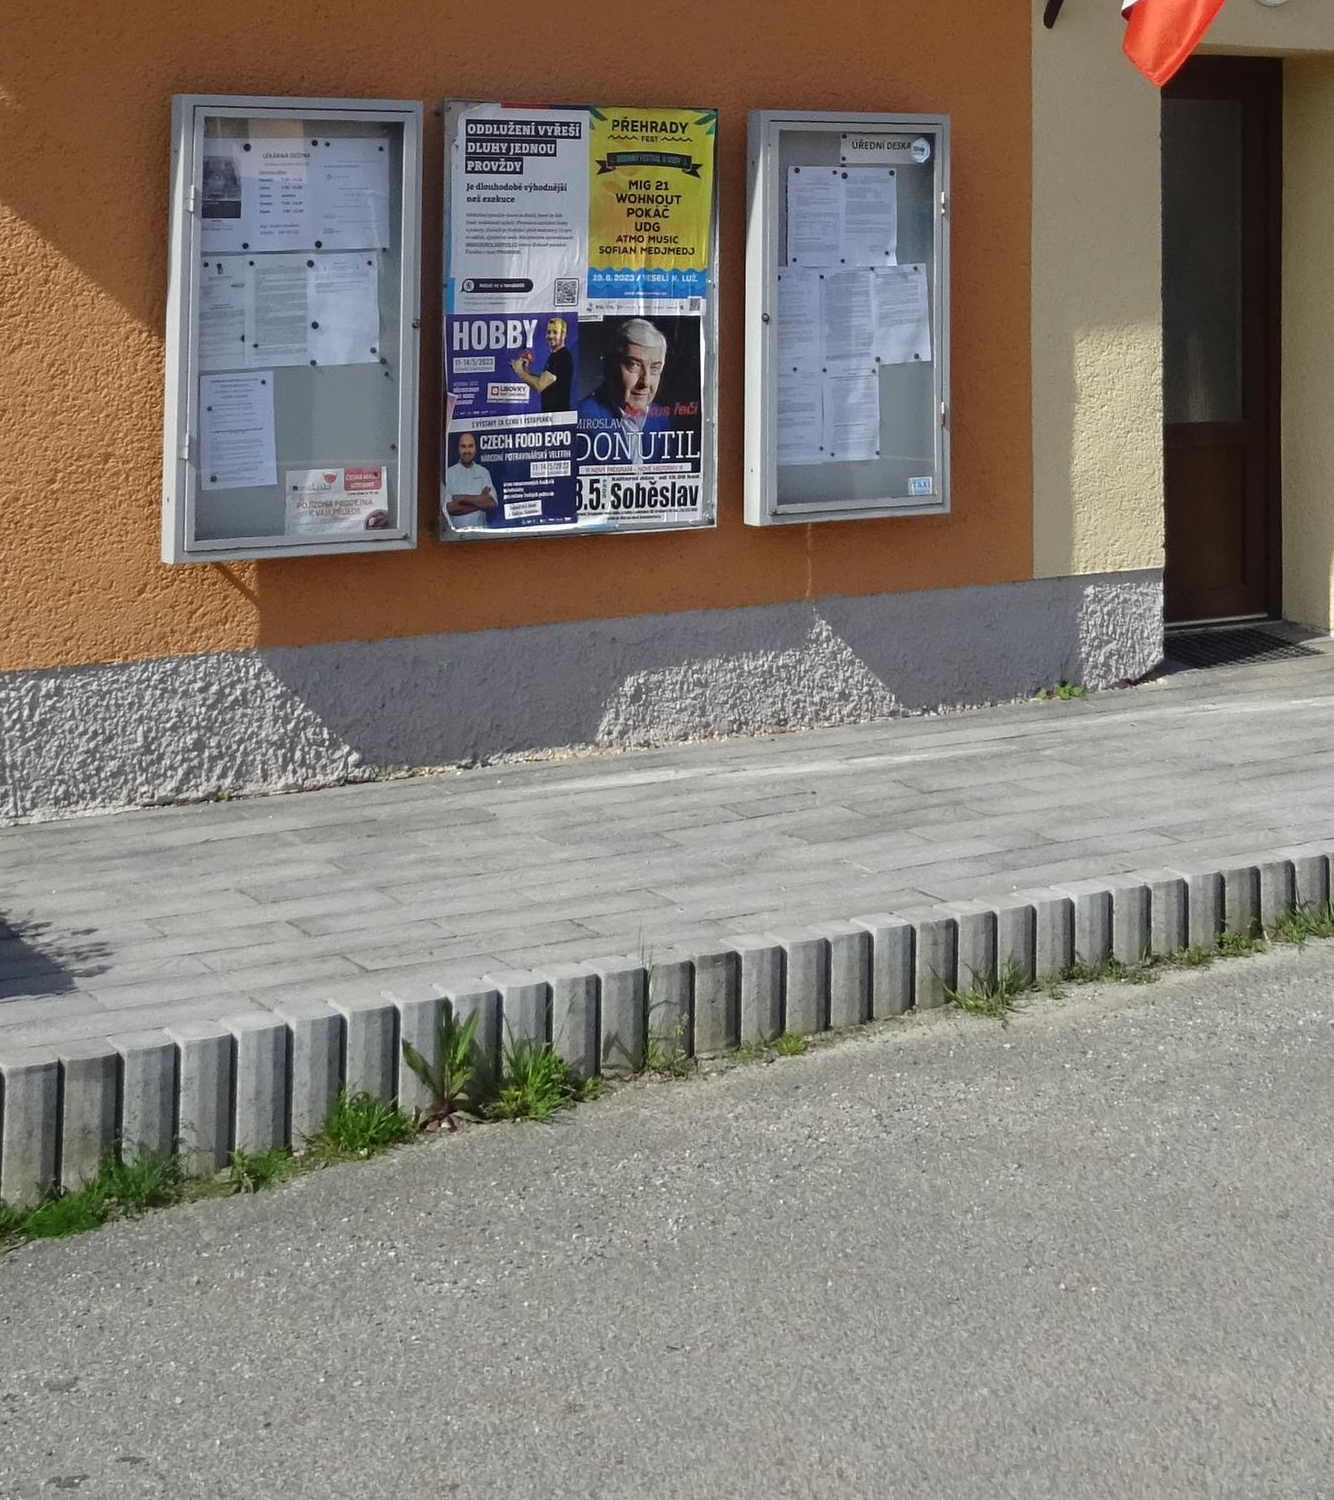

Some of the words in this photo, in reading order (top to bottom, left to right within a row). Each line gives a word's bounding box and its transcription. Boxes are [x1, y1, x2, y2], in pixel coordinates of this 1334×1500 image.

[467, 121, 535, 136] ODDLUŽENÍ
[537, 122, 580, 137] VYŘEŠÍ
[611, 116, 689, 134] PŘEHRADY
[641, 135, 658, 143] FEST
[851, 139, 885, 150] ÚŘEDNÍ
[886, 141, 912, 150] DESKA
[467, 142, 508, 153] DLUHY
[509, 143, 555, 155] JEDNOU
[466, 158, 522, 172] PROVŽDY
[466, 183, 475, 192] Je
[475, 183, 523, 192] dlouhodobě
[523, 183, 568, 193] výhodnější
[628, 180, 651, 191] MIG
[655, 180, 669, 191] 21
[466, 195, 481, 203] než
[482, 195, 515, 203] exekuce
[615, 193, 682, 205] WOHNOUT
[626, 205, 670, 219] POKÁČ
[634, 221, 661, 233] UDG
[616, 234, 645, 243] ATMO
[647, 235, 679, 244] MUSIC
[598, 245, 637, 255] SOFIAN
[640, 246, 695, 256] MEDJMEDJ
[452, 319, 538, 351] HOBBY
[576, 418, 623, 430] MIROSLAV
[479, 433, 513, 450] CZECH
[515, 432, 542, 448] FOOD
[545, 431, 571, 447] EXPO
[576, 430, 701, 462] DONUTIL
[610, 481, 699, 510] Soběslav
